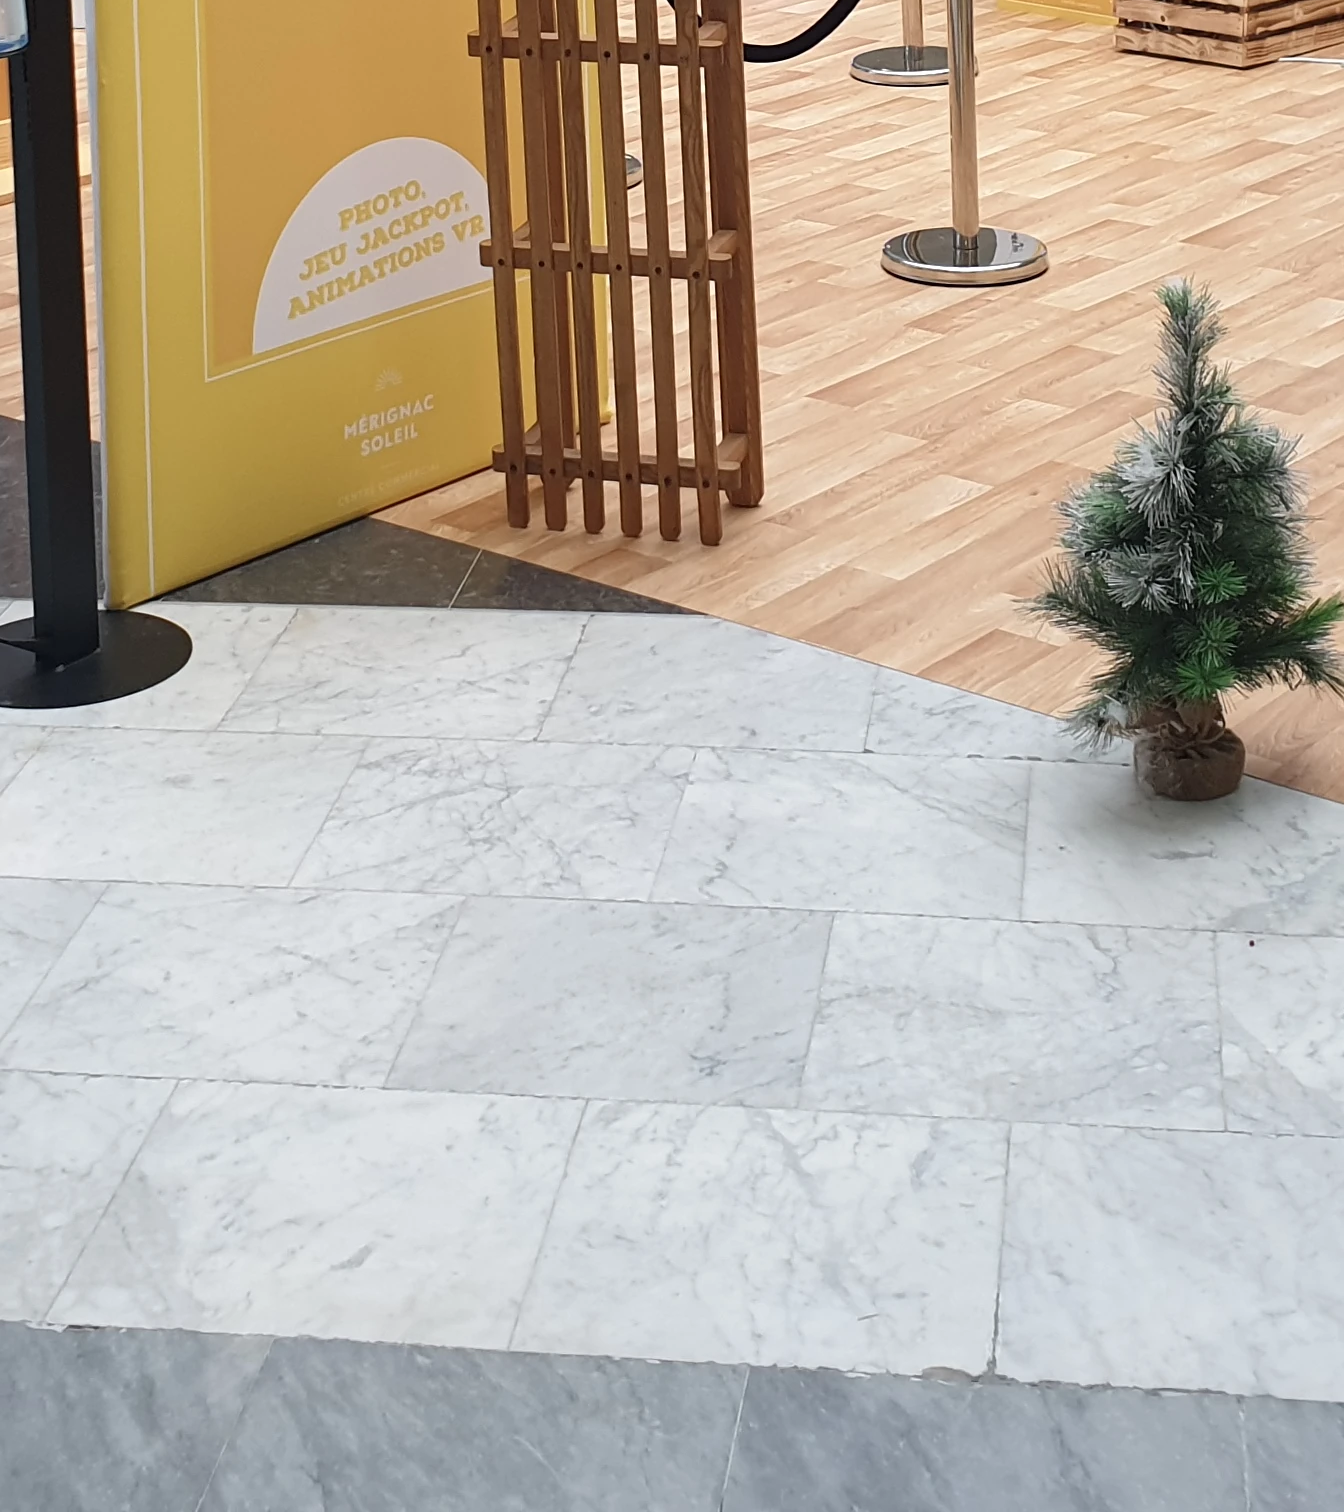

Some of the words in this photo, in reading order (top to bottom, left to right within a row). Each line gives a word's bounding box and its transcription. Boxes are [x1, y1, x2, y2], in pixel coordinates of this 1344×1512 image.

[287, 232, 446, 320] ANIMATIONS
[451, 215, 486, 242] VR
[299, 242, 348, 281] JEU
[343, 394, 434, 440] MÉRIGNAC
[360, 422, 419, 457] SOLEIL
